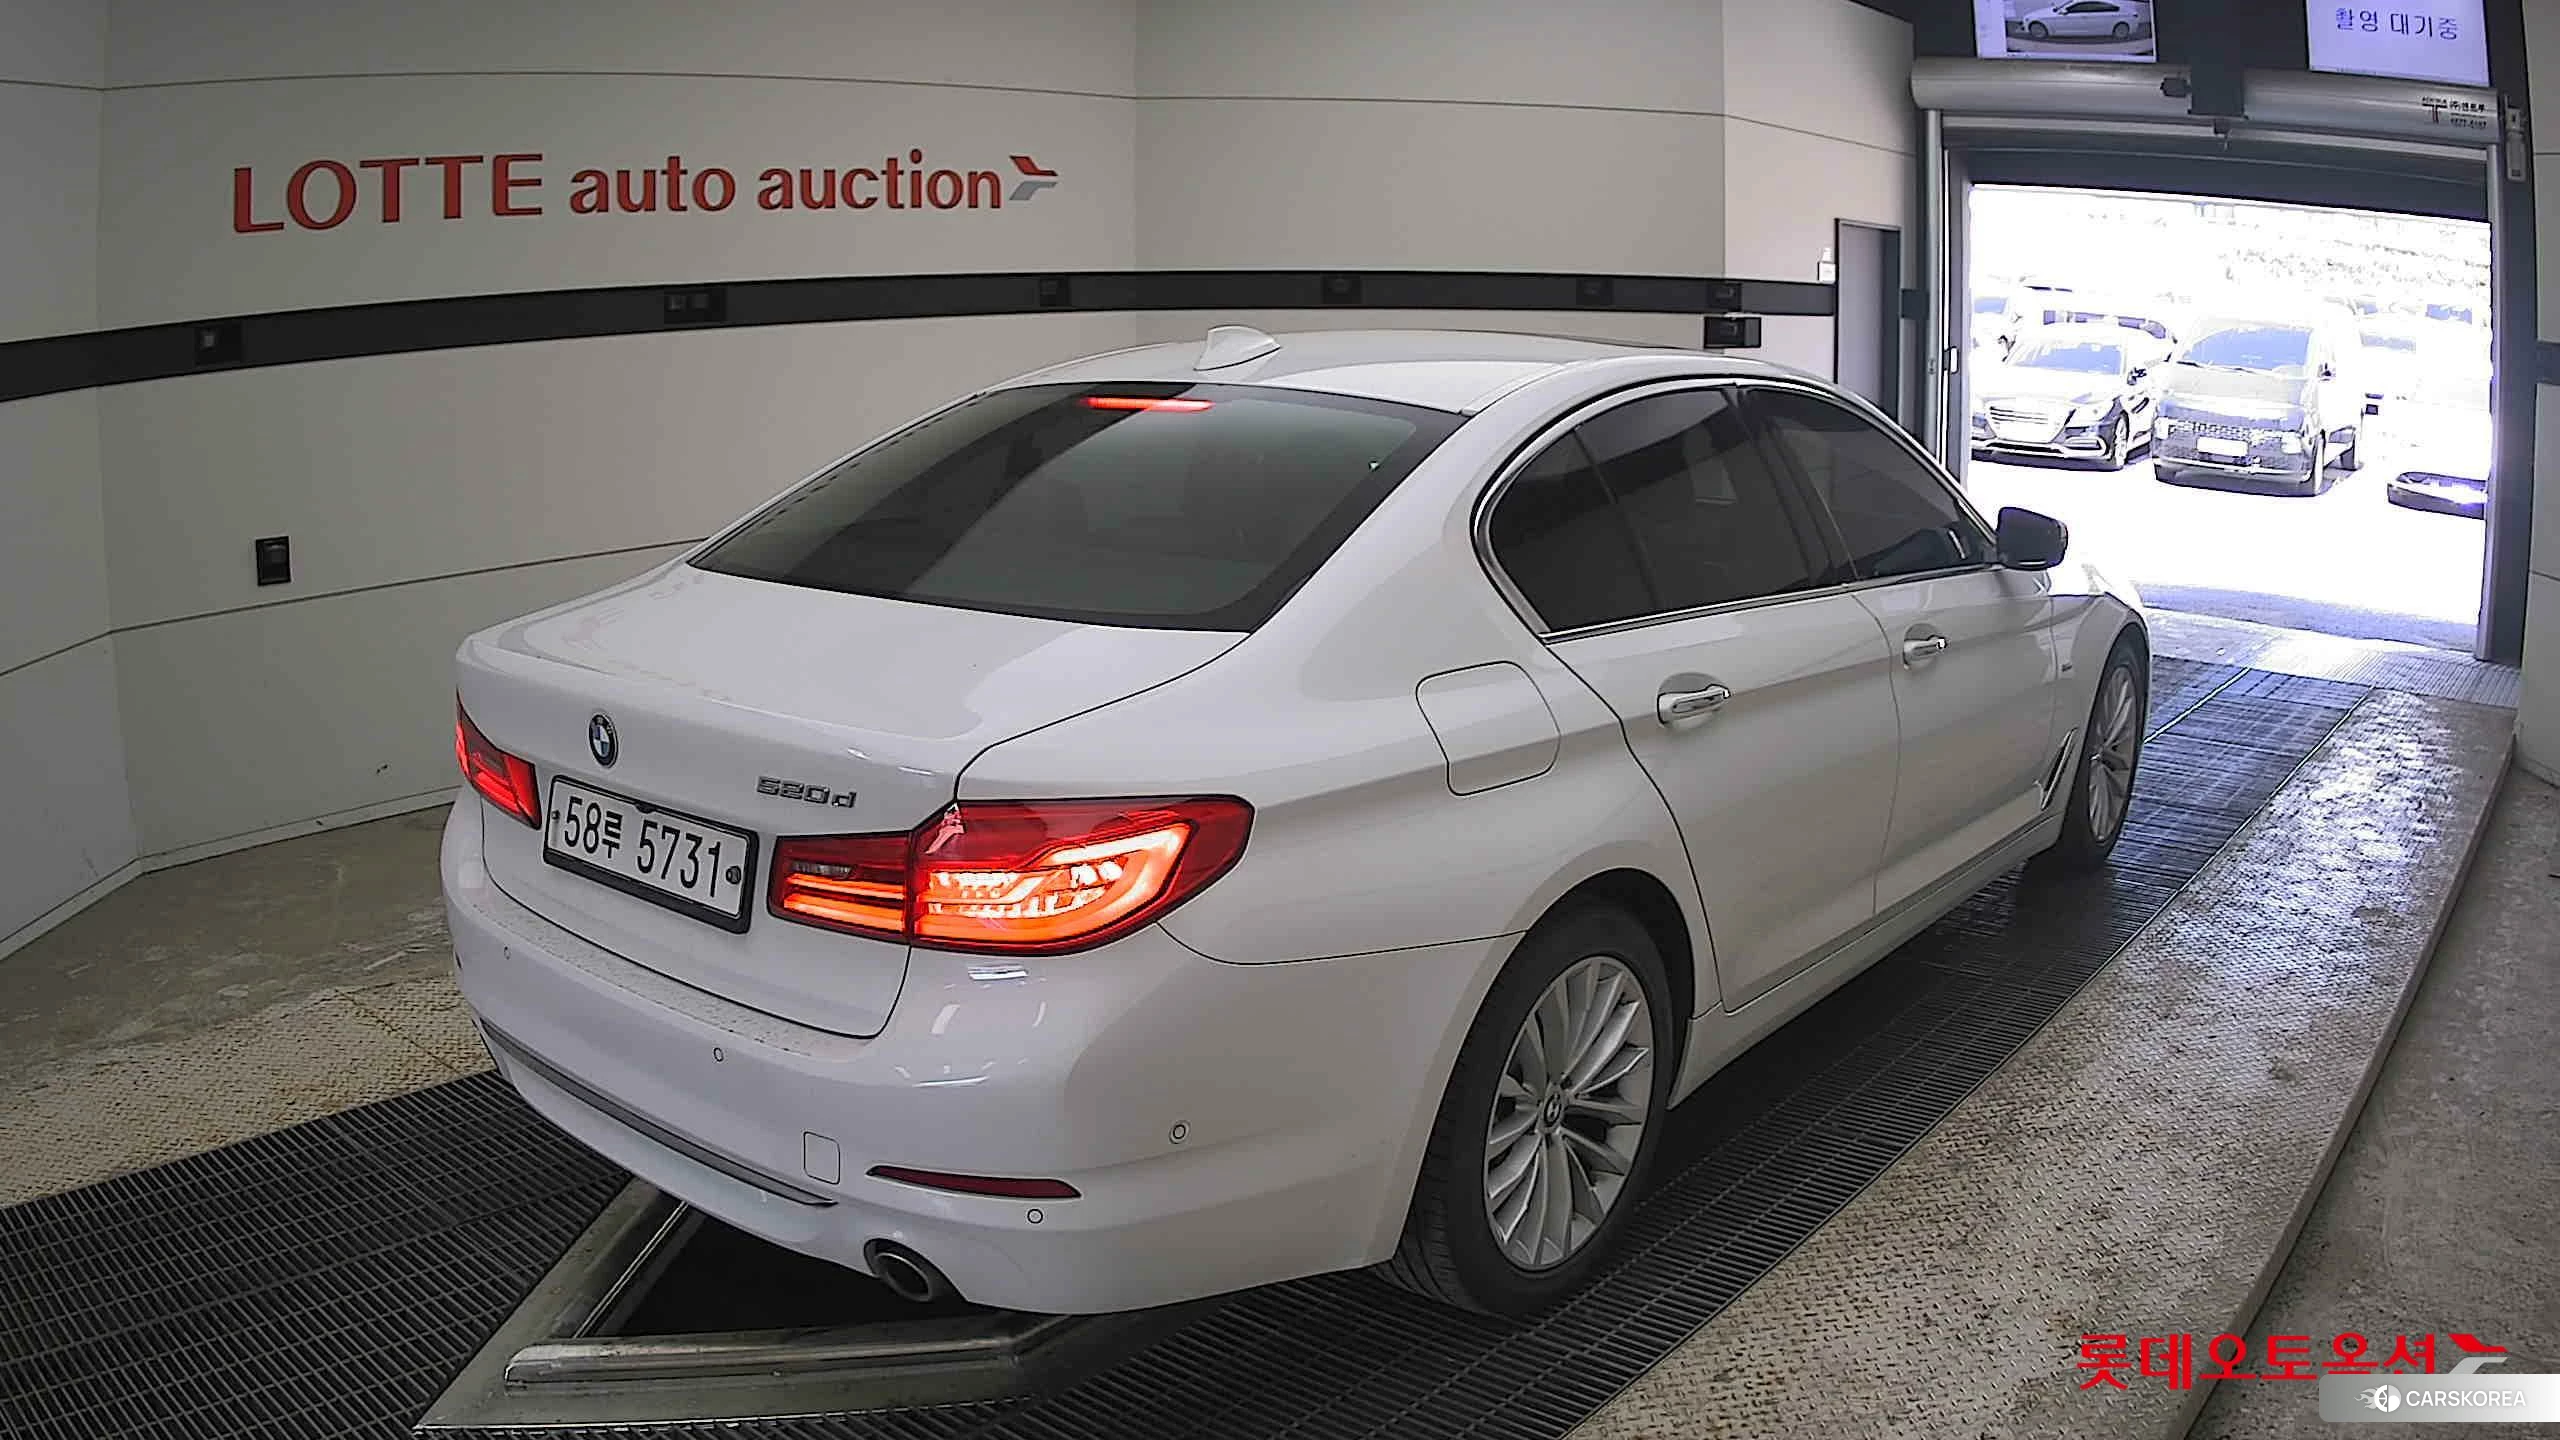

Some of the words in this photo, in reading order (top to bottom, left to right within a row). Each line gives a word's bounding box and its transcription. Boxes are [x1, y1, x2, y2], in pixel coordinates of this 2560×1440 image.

[2335, 7, 2379, 33] 촬영
[235, 155, 542, 233] LOTTE
[570, 157, 736, 214] auto
[757, 149, 1003, 211] auction
[756, 775, 858, 809] 520d
[564, 795, 623, 859] 58루
[637, 818, 722, 898] 5731
